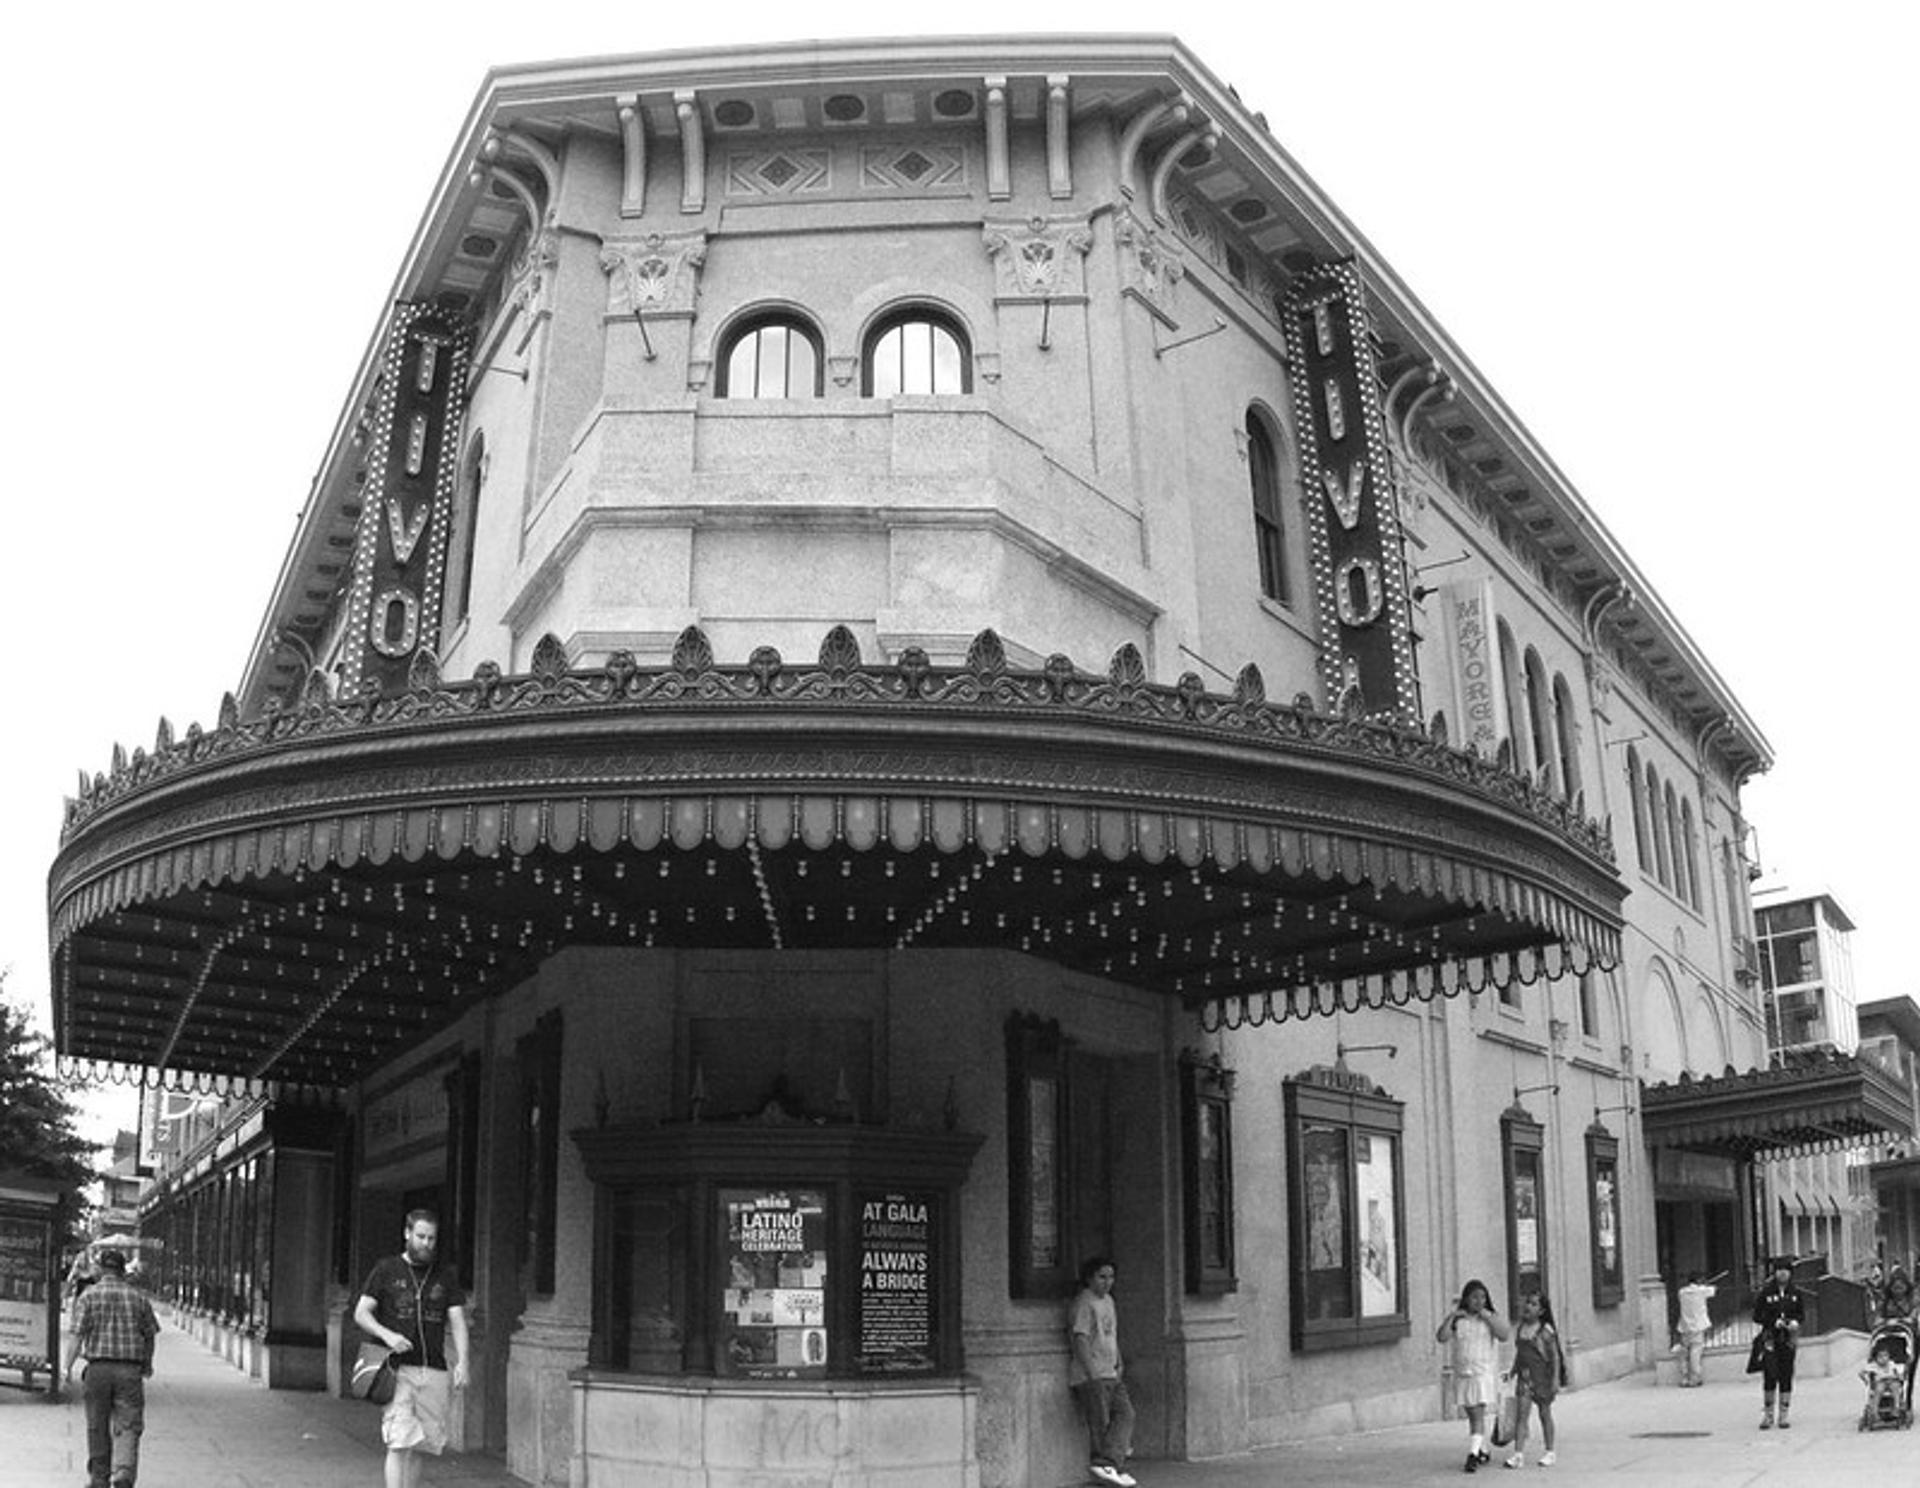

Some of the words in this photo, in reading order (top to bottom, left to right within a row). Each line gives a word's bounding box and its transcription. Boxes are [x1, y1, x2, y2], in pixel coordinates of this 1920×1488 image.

[1455, 598, 1495, 742] MAYORGA
[742, 1213, 803, 1229] LATINO
[863, 1203, 883, 1221] AT
[888, 1203, 928, 1223] GALA
[742, 1229, 803, 1242] HERITAGE
[863, 1223, 928, 1240] LANGUAGE
[862, 1252, 928, 1271] ALWAYS
[862, 1272, 873, 1290] A
[876, 1272, 928, 1291] BRIDGE
